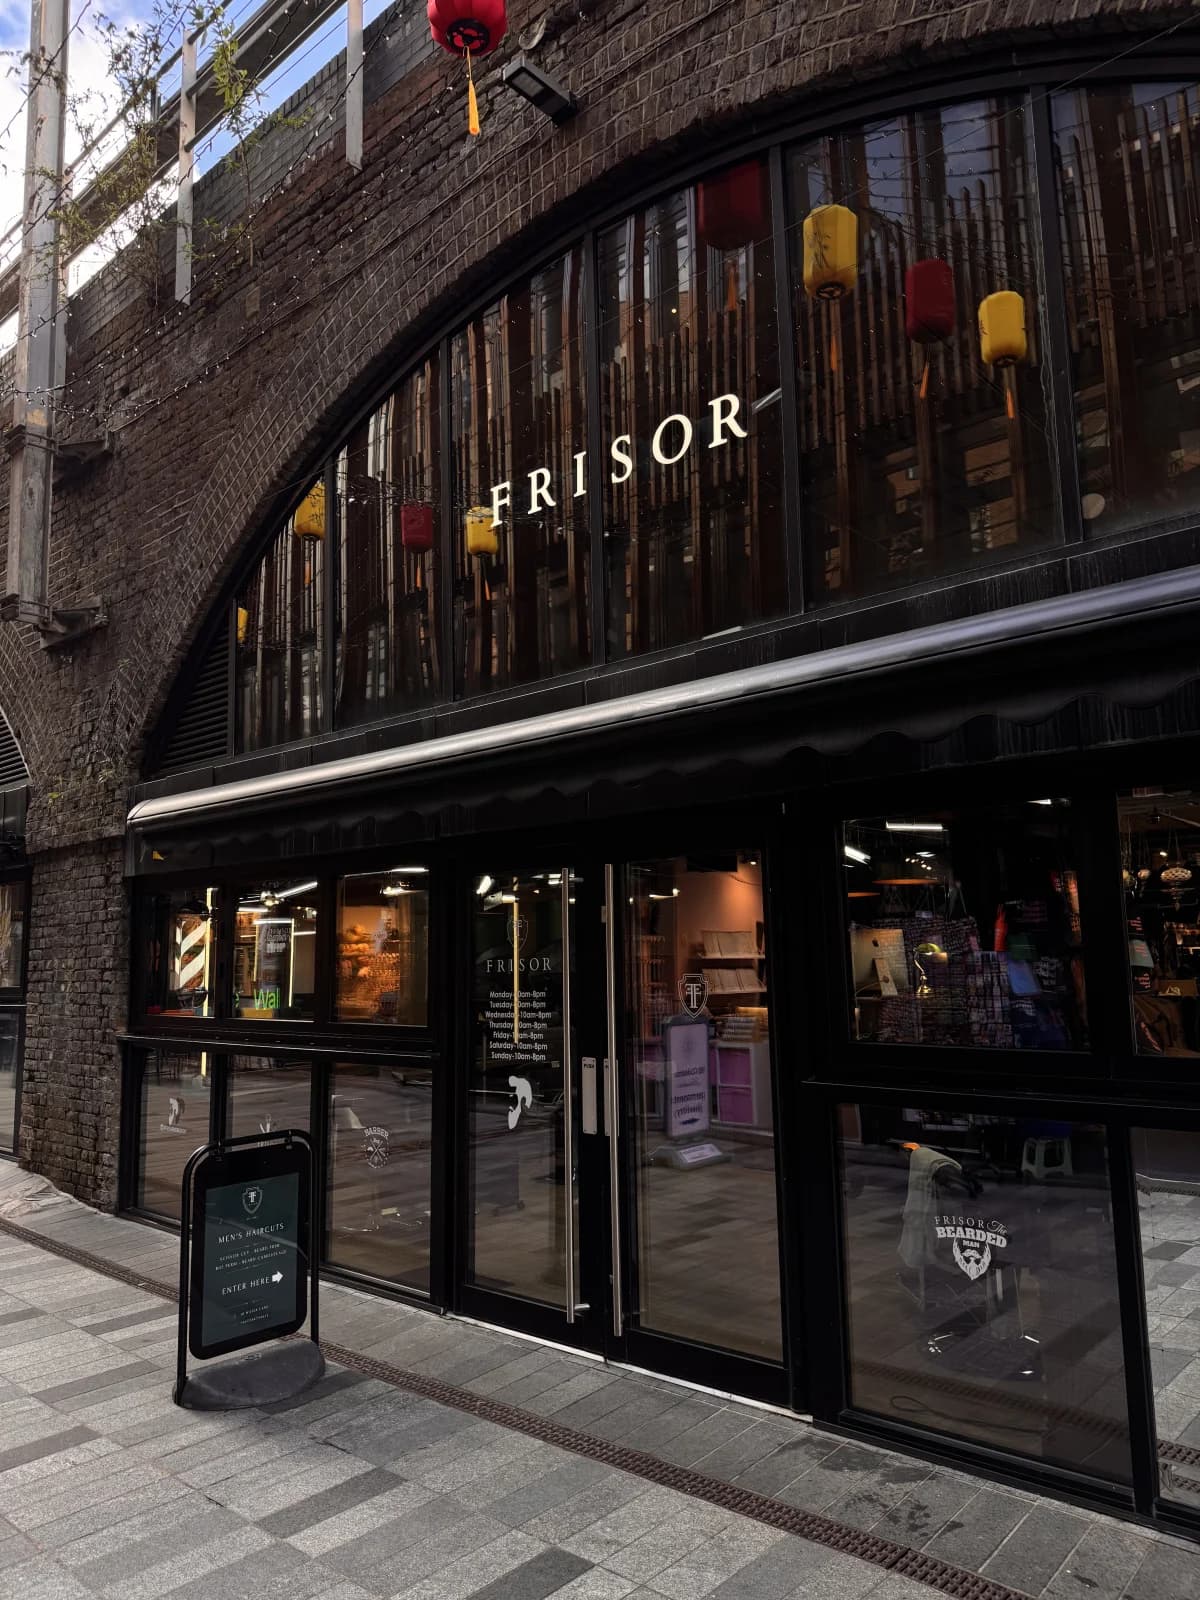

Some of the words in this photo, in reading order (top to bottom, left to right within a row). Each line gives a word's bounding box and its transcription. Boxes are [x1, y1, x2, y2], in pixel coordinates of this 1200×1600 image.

[490, 393, 748, 528] FRISOR
[486, 957, 552, 973] FRISOR
[489, 990, 546, 1000] Monday-0am-8pm
[490, 1000, 546, 1010] Tuesday-0am-8pm
[485, 1010, 552, 1020] Wednesda-10am-8pm
[493, 1030, 544, 1041] Friday-1am-8pm
[491, 1051, 546, 1061] Sunday-10am-8pm
[934, 1215, 984, 1229] FRISOR
[218, 1231, 243, 1244] MEN'S
[246, 1222, 284, 1238] HAIRCUTS
[935, 1226, 1008, 1248] BEARDED
[962, 1239, 980, 1248] MAN
[222, 1282, 246, 1296] ENTER
[250, 1276, 270, 1288] HERE
